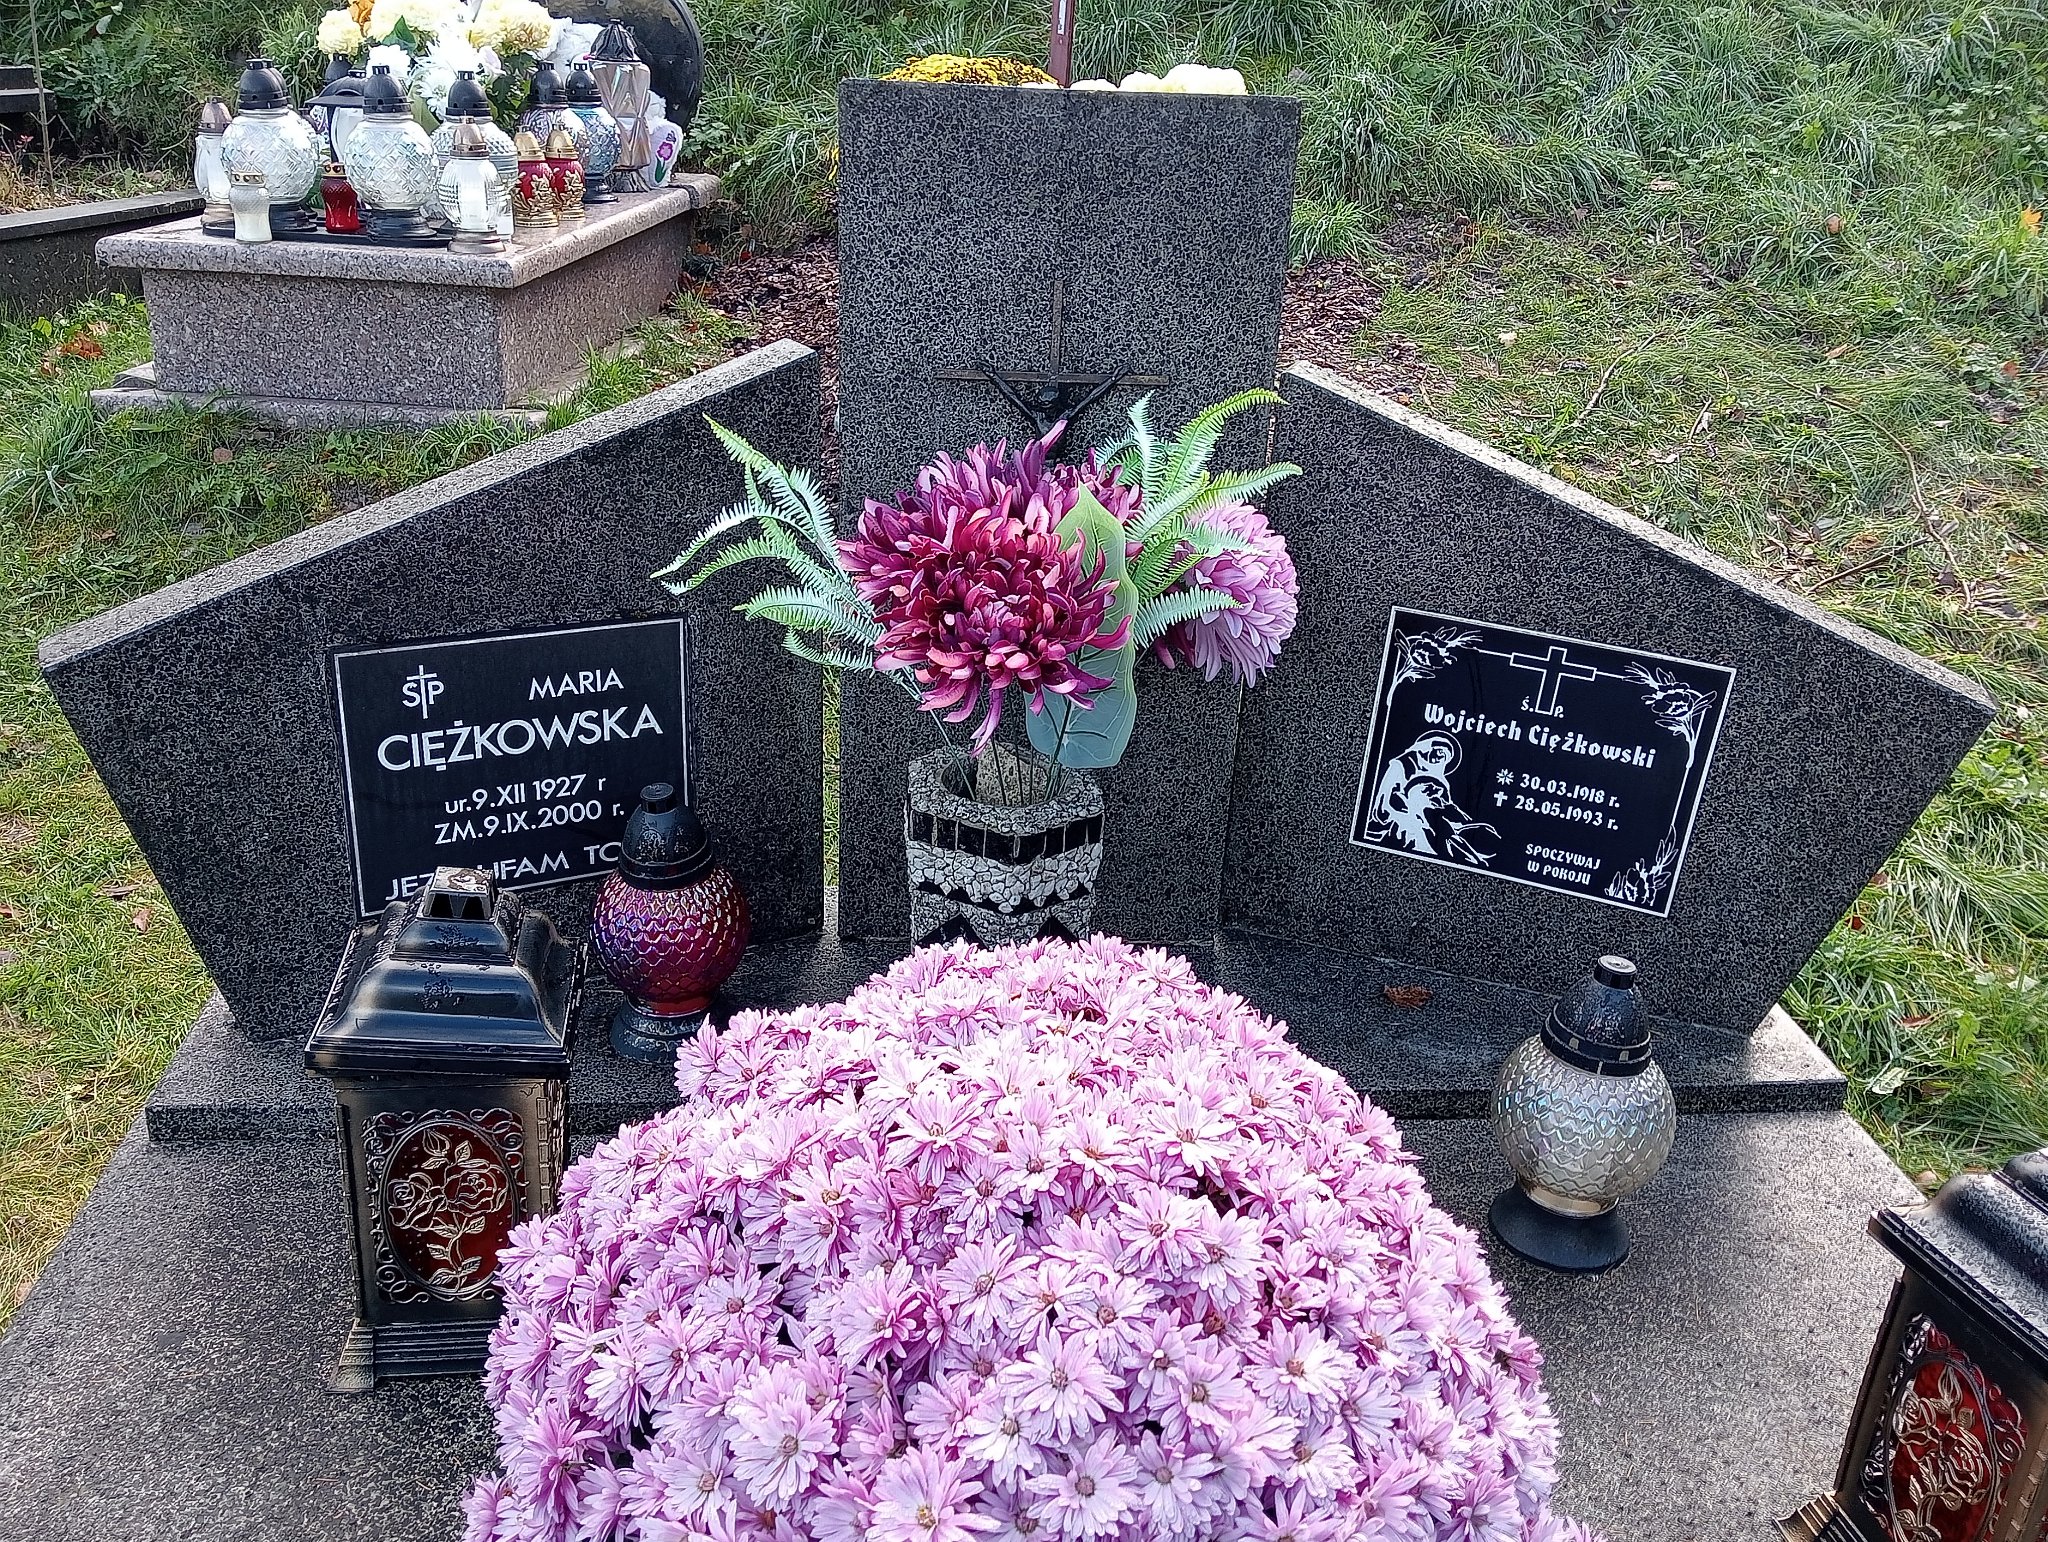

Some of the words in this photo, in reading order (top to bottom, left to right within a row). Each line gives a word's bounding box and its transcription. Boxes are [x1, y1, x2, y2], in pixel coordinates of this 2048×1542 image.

[528, 667, 625, 701] MARIA
[376, 703, 664, 772] CIĘŻKOWSKA
[1423, 702, 1522, 742] Wojciech
[1527, 724, 1657, 769] Ciężkowski
[531, 773, 588, 801] 1927
[1519, 773, 1606, 804] 30.03.1918
[1608, 795, 1620, 808] r.
[433, 799, 603, 845] ZM.9.IX.2000
[611, 802, 626, 817] r.
[1514, 794, 1604, 827] 28.05.1993
[1606, 818, 1619, 831] r.
[1524, 843, 1601, 870] SPOCZYWAJ
[1526, 859, 1540, 873] W
[1542, 864, 1592, 886] POKOJU
[385, 872, 436, 901] JEZ
